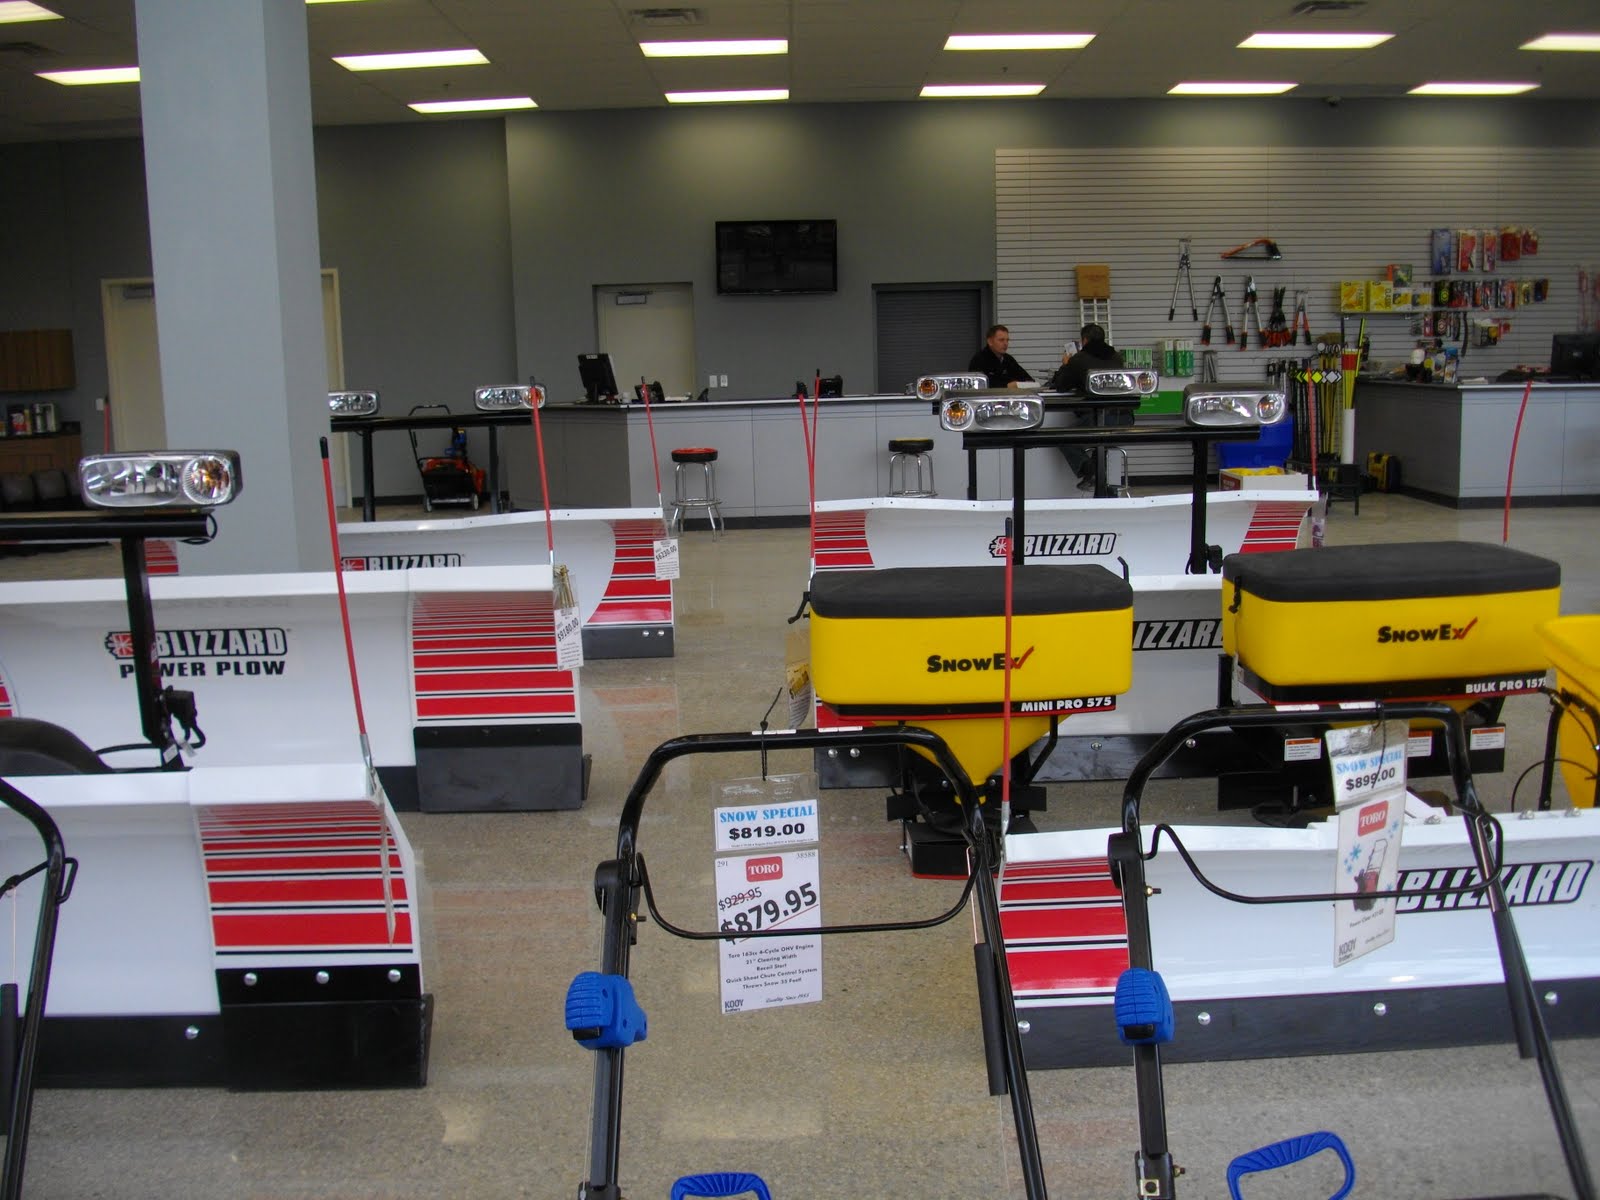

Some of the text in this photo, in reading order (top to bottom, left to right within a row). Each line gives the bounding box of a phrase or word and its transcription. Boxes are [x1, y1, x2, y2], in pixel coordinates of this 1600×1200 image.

[1024, 533, 1115, 555] BLIZZARD
[155, 629, 287, 657] BLIZZARD
[1132, 619, 1223, 649] IZZAR
[120, 660, 286, 679] PWER PLOW
[1465, 682, 1496, 694] BULK
[1500, 680, 1523, 691] PRO
[1021, 697, 1112, 712] MINI PRO 575
[1336, 760, 1367, 774] SNOW
[1345, 767, 1395, 791] $899.00
[720, 805, 815, 823] SNOW SPECIAL
[1360, 810, 1385, 827] TORO
[729, 823, 805, 841] $819.00
[747, 863, 780, 875] TORO
[718, 887, 762, 912] $929.95
[720, 882, 817, 945] $879.95
[1339, 938, 1357, 956] KOOY
[725, 999, 744, 1008] KOOY
